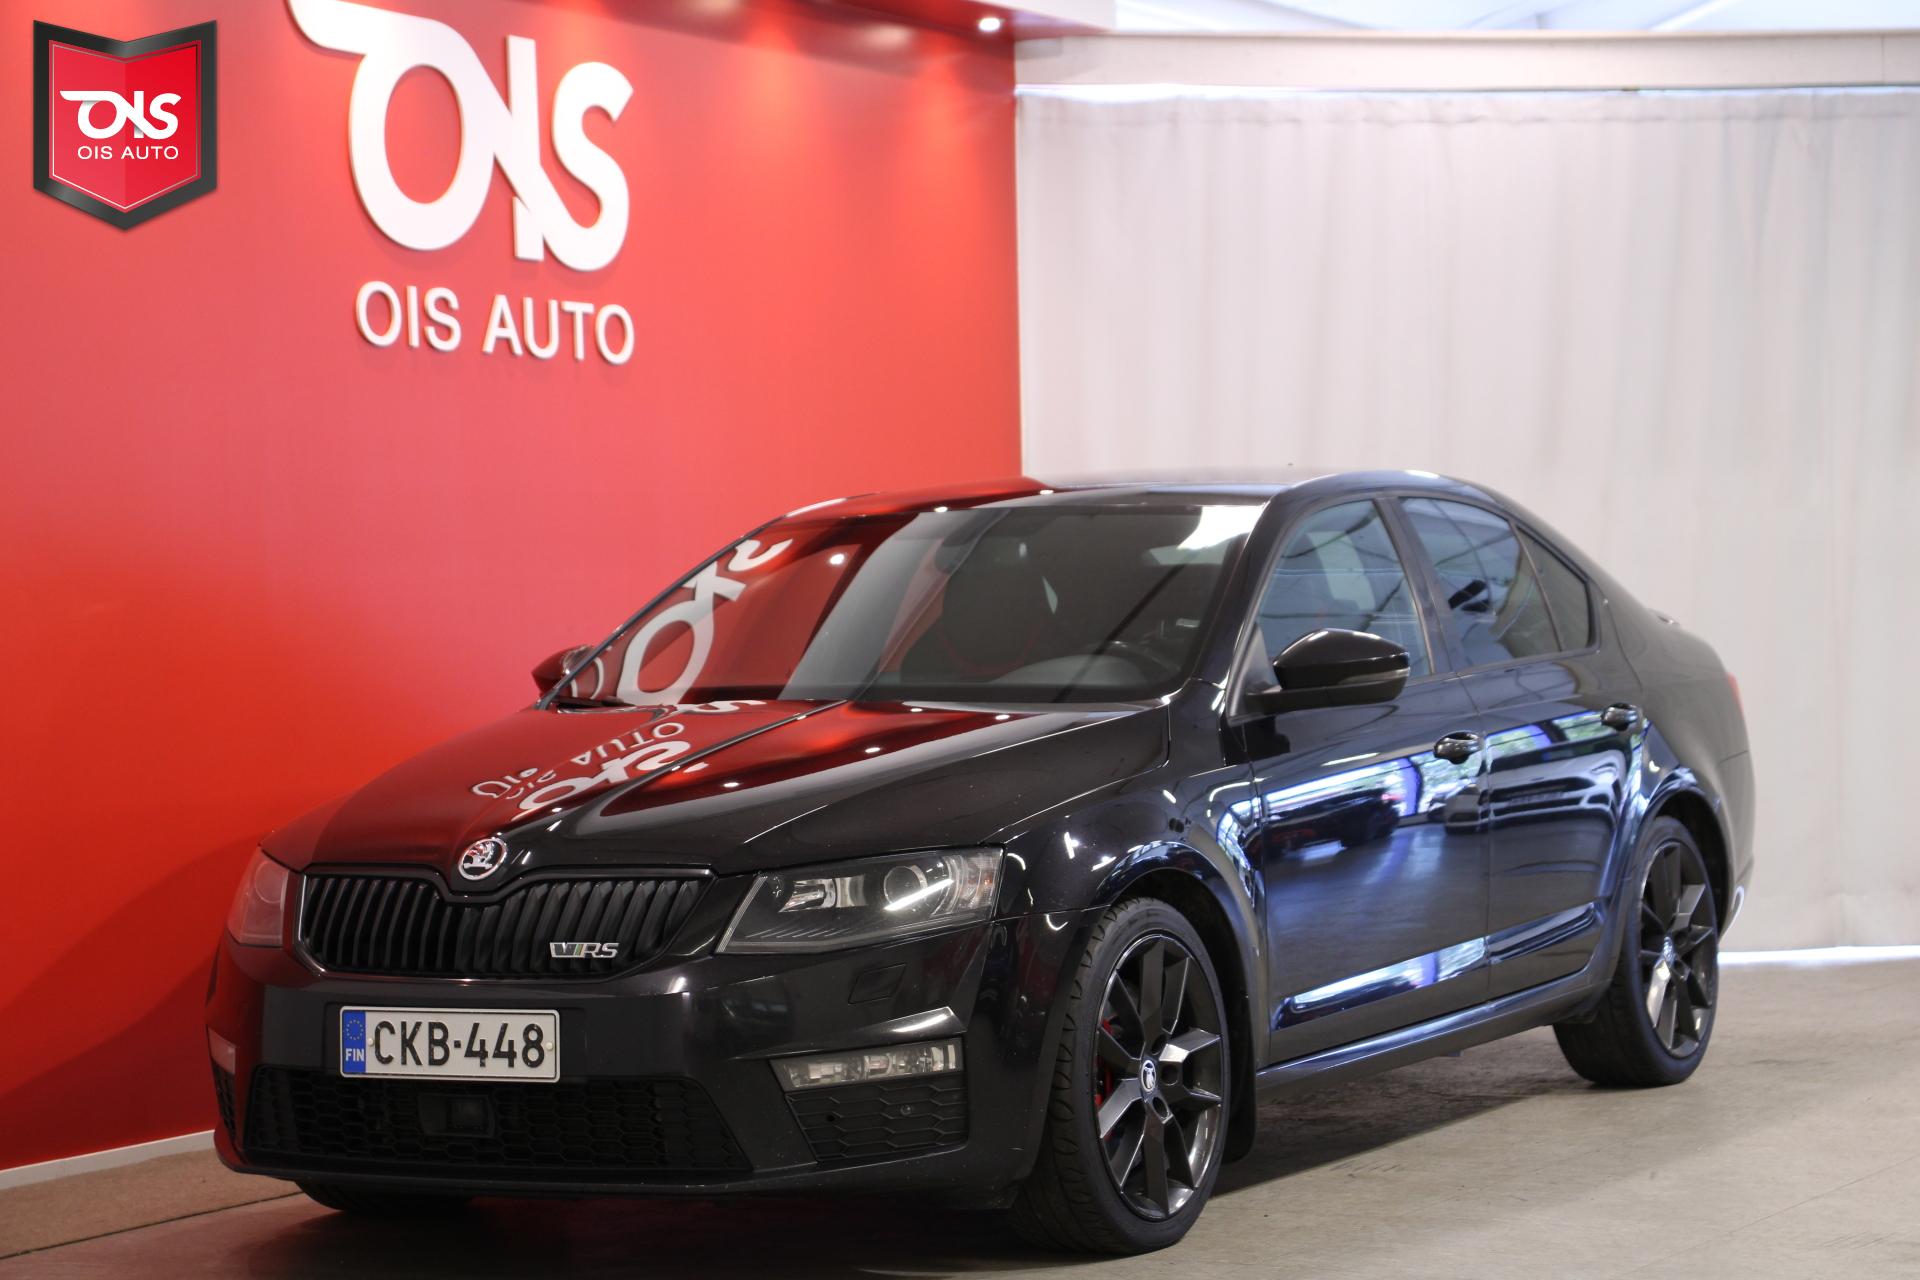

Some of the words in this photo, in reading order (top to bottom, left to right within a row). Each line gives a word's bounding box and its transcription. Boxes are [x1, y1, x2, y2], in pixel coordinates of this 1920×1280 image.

[355, 280, 462, 352] OIS
[482, 294, 635, 365] AUTO
[345, 1048, 365, 1062] FIN
[374, 1020, 545, 1069] CKB-448
